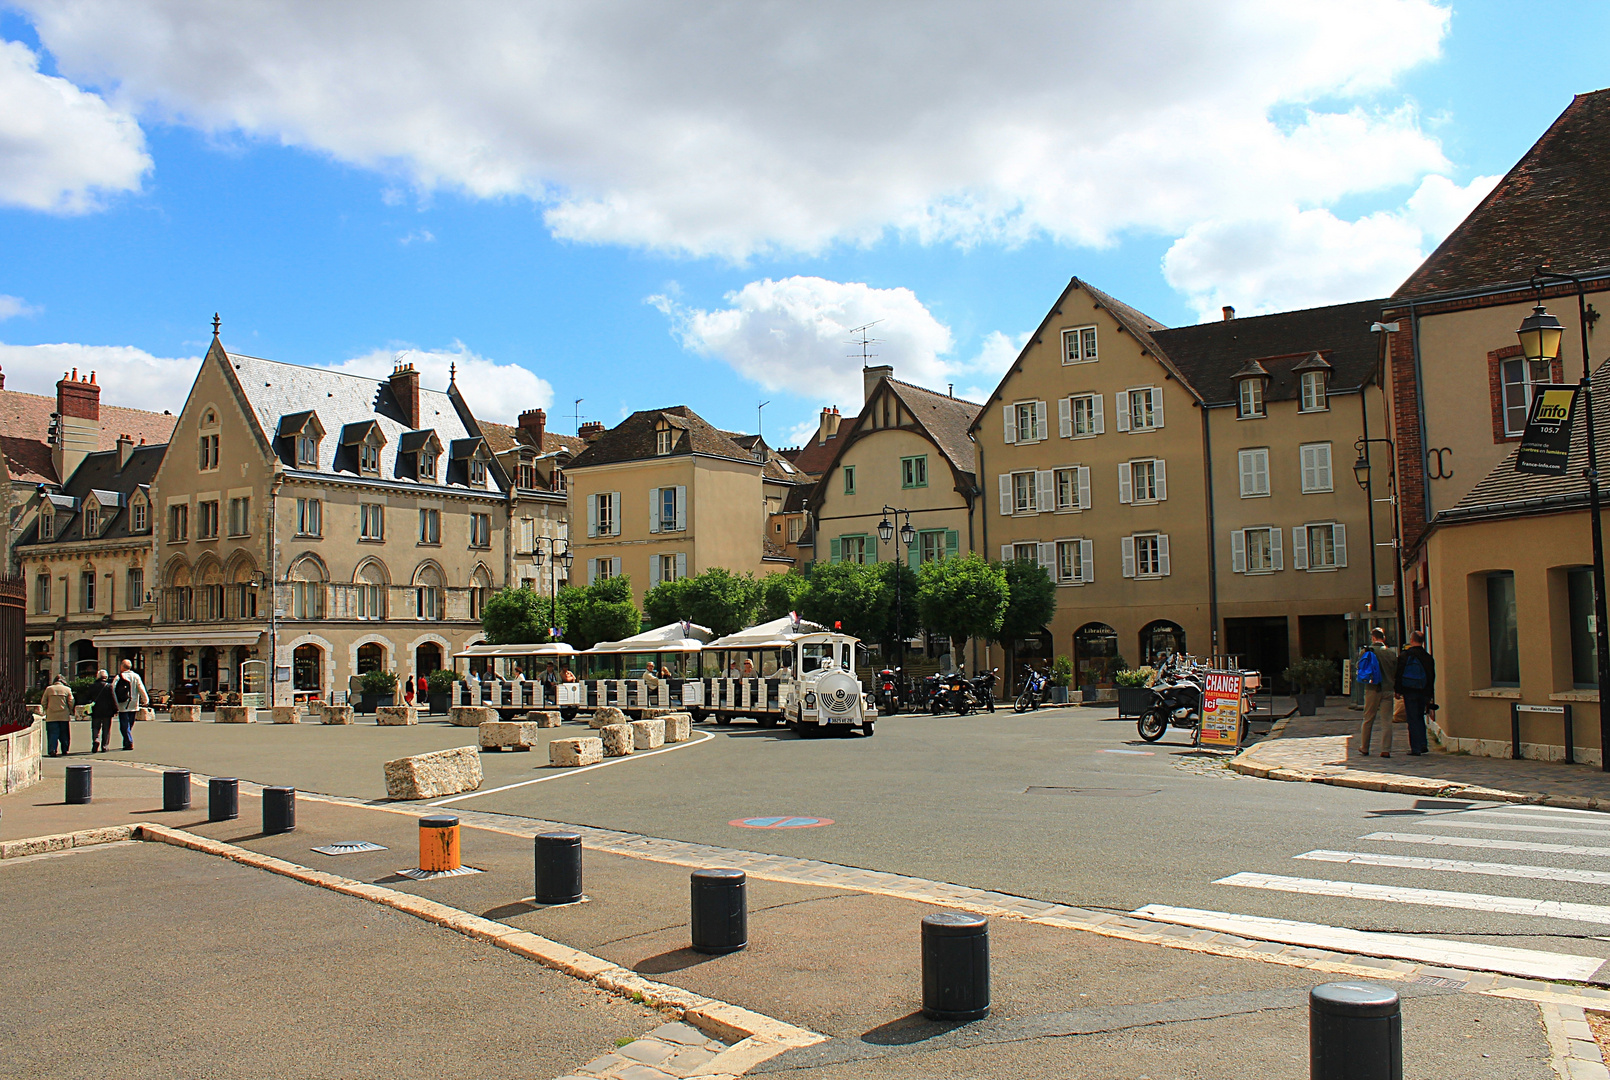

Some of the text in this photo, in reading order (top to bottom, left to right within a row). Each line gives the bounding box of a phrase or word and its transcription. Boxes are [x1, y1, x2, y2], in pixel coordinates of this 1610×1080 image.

[1540, 404, 1567, 417] info
[1206, 675, 1239, 693] CHANGE
[1205, 699, 1215, 708] ici
